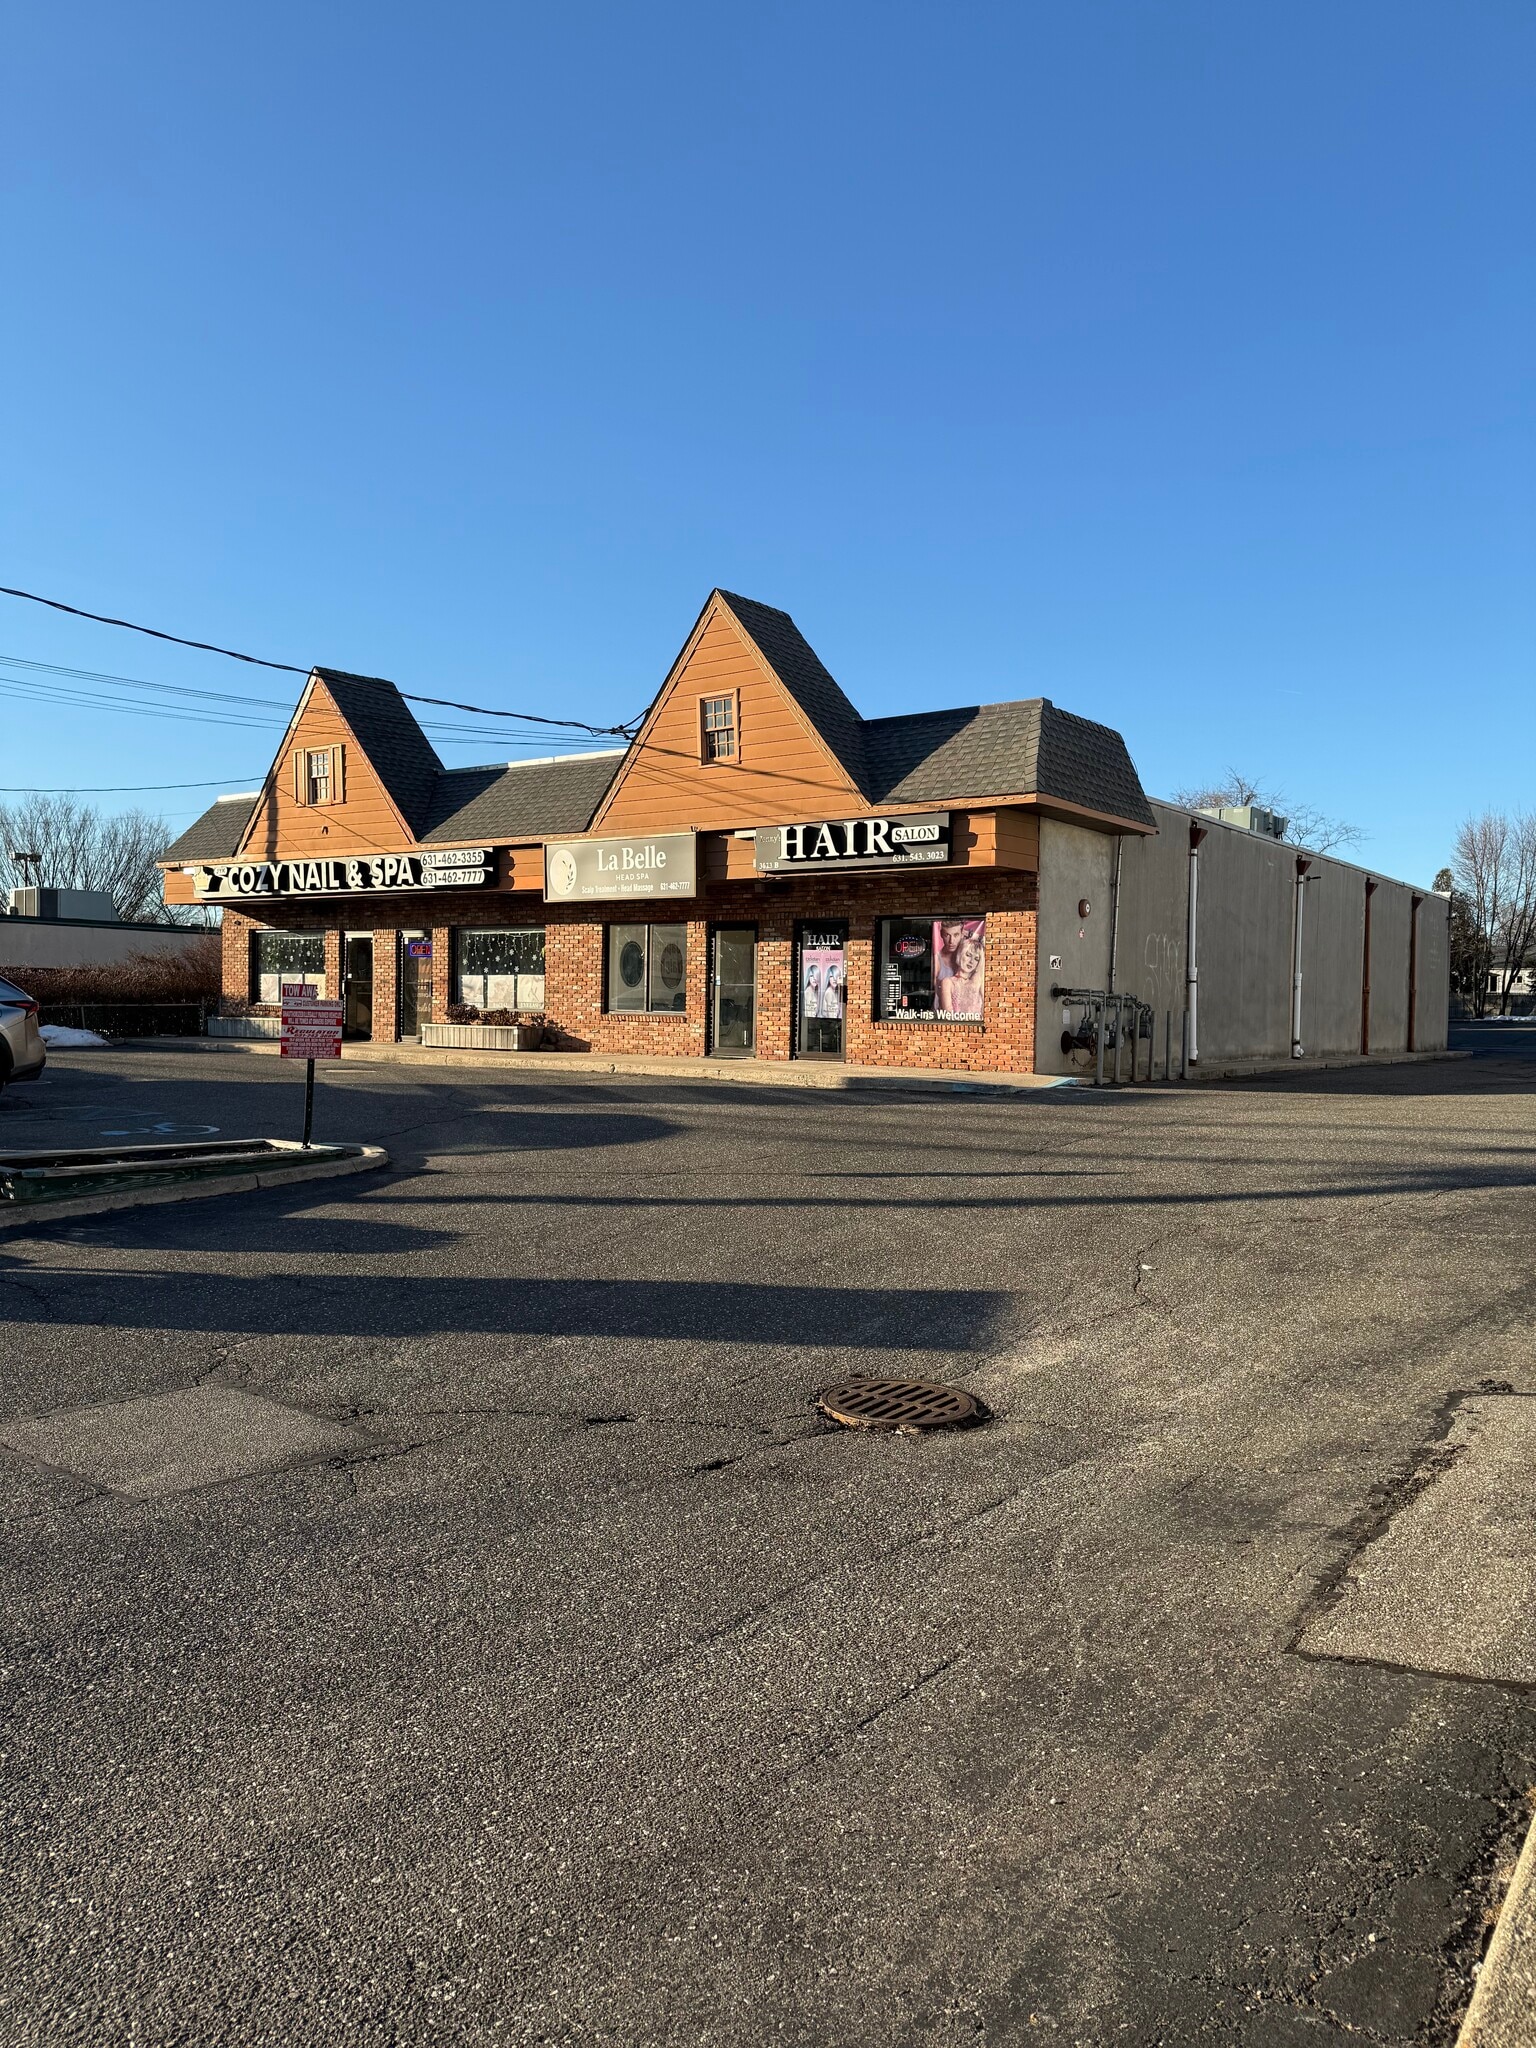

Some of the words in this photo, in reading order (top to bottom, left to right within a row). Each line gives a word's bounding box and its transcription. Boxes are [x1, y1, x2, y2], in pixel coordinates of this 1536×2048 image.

[777, 819, 894, 860] HAIR
[894, 827, 937, 841] SALON
[421, 852, 483, 866] 631-462-3355
[596, 849, 618, 872] La
[621, 845, 667, 870] Belle
[926, 851, 945, 861] 3023
[228, 863, 283, 892] COZY
[289, 861, 340, 890] NAIL
[347, 859, 364, 887] &
[371, 856, 415, 887] SPA
[422, 870, 483, 885] 631-462-7777
[615, 873, 635, 881] HEAD
[636, 872, 650, 880] SPA
[581, 886, 595, 895] Scalp
[620, 884, 633, 893] Head
[633, 883, 654, 893] Massage
[806, 934, 841, 946] HAIR
[411, 944, 431, 955] OPEN
[895, 941, 923, 953] OPEN
[285, 985, 299, 996] TOW
[302, 985, 317, 997] AWA
[895, 1008, 934, 1020] Walk-ins
[936, 1009, 982, 1021] Welcome
